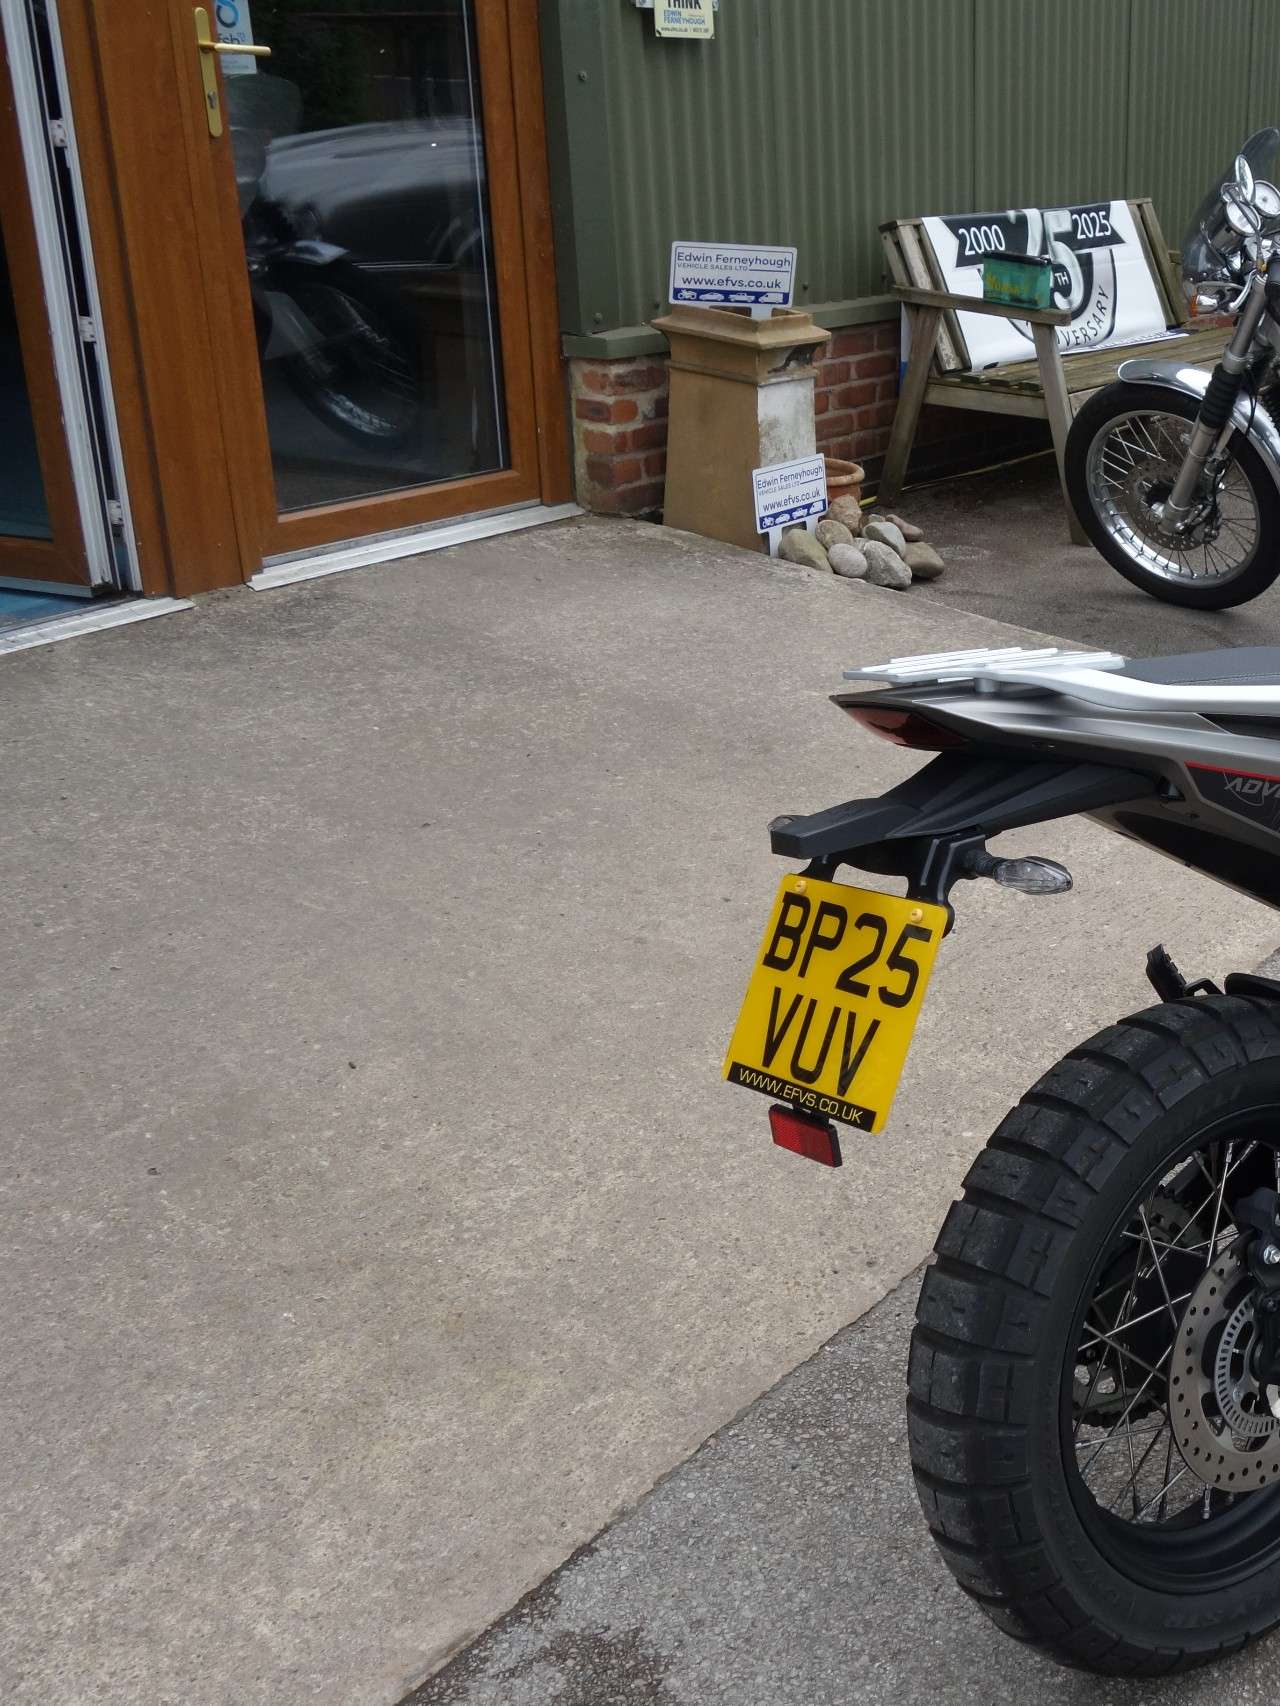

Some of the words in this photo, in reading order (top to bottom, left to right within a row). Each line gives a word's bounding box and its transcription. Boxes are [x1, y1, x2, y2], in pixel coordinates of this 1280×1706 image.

[667, 0, 702, 9] THINK
[1071, 210, 1112, 240] 2025
[958, 224, 1006, 256] 2000
[677, 251, 712, 262] Edwin
[716, 254, 791, 268] Ferneyhough
[682, 276, 782, 289] www.efvs.co.uk
[1054, 271, 1070, 286] TH
[1056, 285, 1109, 346] VERSARY
[757, 476, 779, 489] Edwin
[779, 465, 823, 482] Ferneyhough
[763, 487, 821, 511] www.efvs.co.uk
[761, 890, 933, 1009] BP25
[761, 986, 882, 1097] VUV
[738, 1067, 864, 1124] WWW.EFVS.CO.UK
